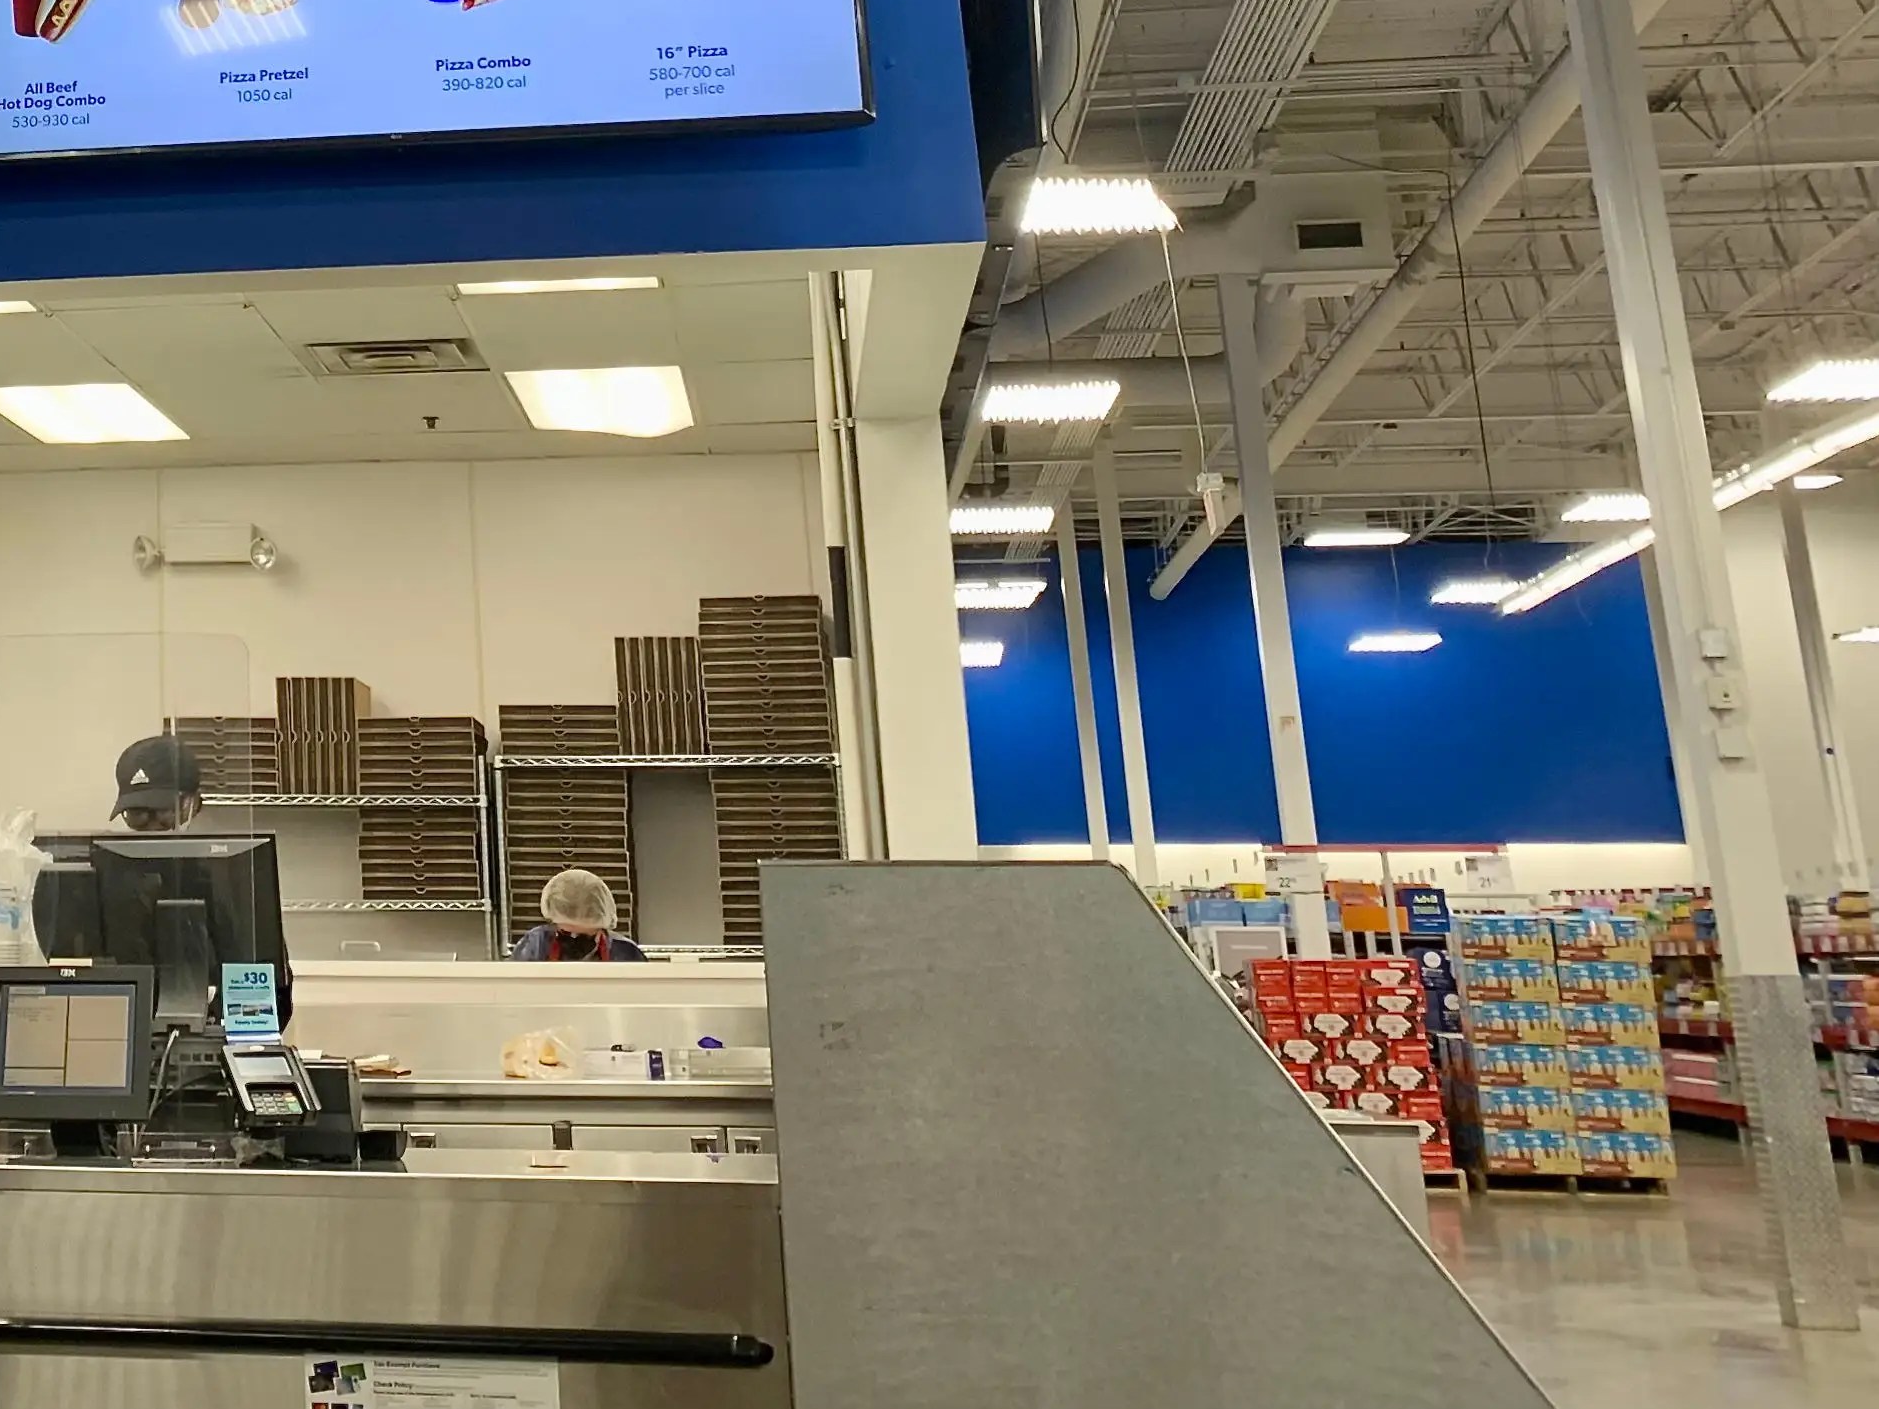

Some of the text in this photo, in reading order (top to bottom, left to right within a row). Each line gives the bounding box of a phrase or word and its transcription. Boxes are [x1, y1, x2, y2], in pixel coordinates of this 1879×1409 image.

[688, 45, 728, 58] Pizza
[435, 55, 531, 72] Pizza Combo
[219, 68, 309, 84] Pizza Pretzel
[649, 64, 736, 81] 580-700 cal
[25, 80, 77, 95] All Beef
[441, 75, 526, 91] 390-820 cal
[664, 82, 725, 99] per slice
[24, 97, 53, 110] Dog
[55, 94, 106, 108] Combo
[237, 88, 292, 103] 1050 cal
[11, 113, 90, 128] 530-930 cal
[244, 972, 268, 985] $30
